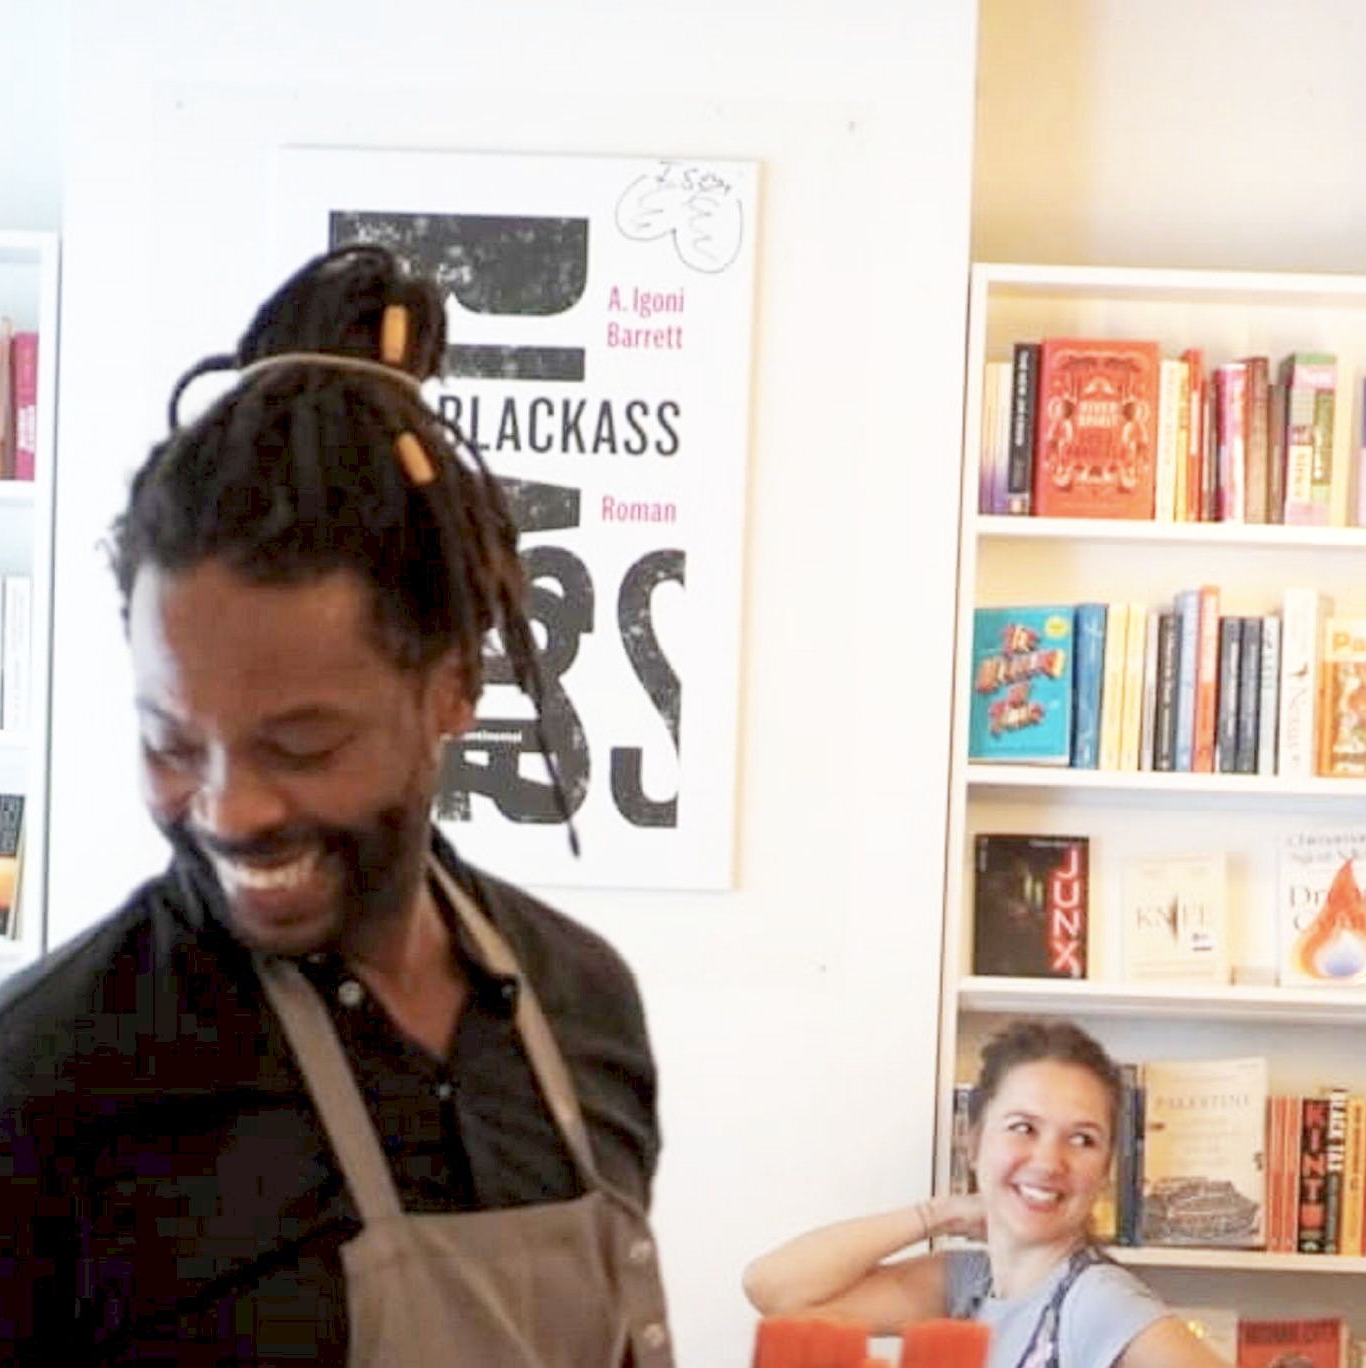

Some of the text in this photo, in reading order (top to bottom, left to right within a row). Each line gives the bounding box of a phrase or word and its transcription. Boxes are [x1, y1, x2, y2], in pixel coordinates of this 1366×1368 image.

[608, 286, 685, 316] A. Igoni
[607, 323, 684, 351] Barrett
[437, 395, 682, 456] BLACKASS
[601, 495, 677, 525] Roman
